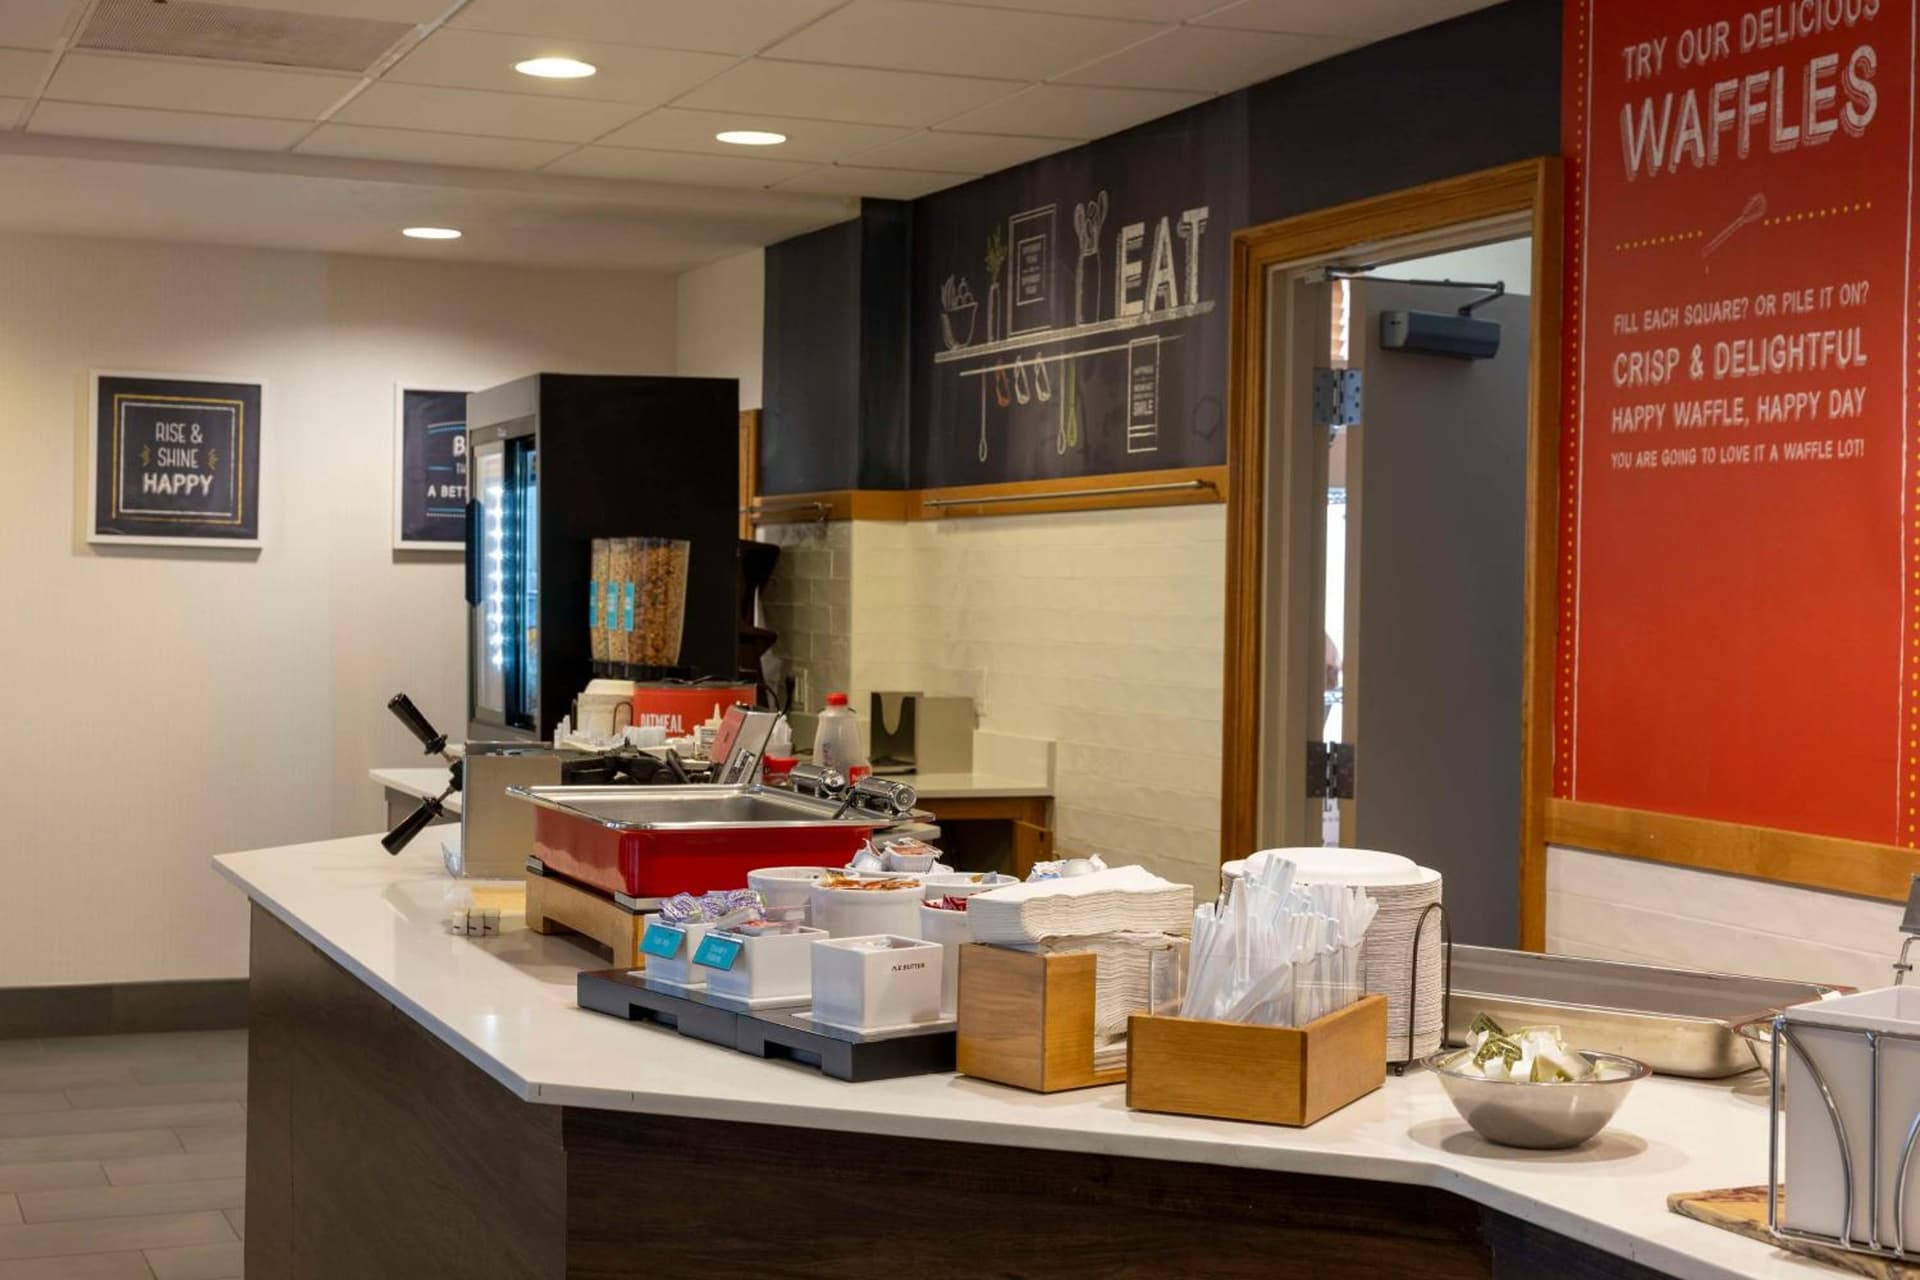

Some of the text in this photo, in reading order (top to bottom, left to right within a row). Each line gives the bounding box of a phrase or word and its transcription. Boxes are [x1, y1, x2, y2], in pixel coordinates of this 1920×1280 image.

[1622, 37, 1668, 81] TRY
[1677, 21, 1730, 68] OUR
[1620, 44, 1879, 182] WAFFLES
[1116, 206, 1210, 316] EAT
[1613, 280, 1870, 336] FILL EACH SQUARE? OR PILE IT ON?
[1613, 327, 1868, 388] CRISP & DELIGHTFUL
[1612, 387, 1867, 434] HAPPY WAFFLE, HAPPY DAY
[155, 422, 204, 443] RISE &
[157, 447, 199, 469] SHINE
[1611, 438, 1865, 469] YOU ARE GOING TO LOVE IT A WAFFLE LOT!
[143, 473, 214, 496] HAPPY
[426, 484, 437, 498] A
[640, 713, 685, 733] OATMEAL
